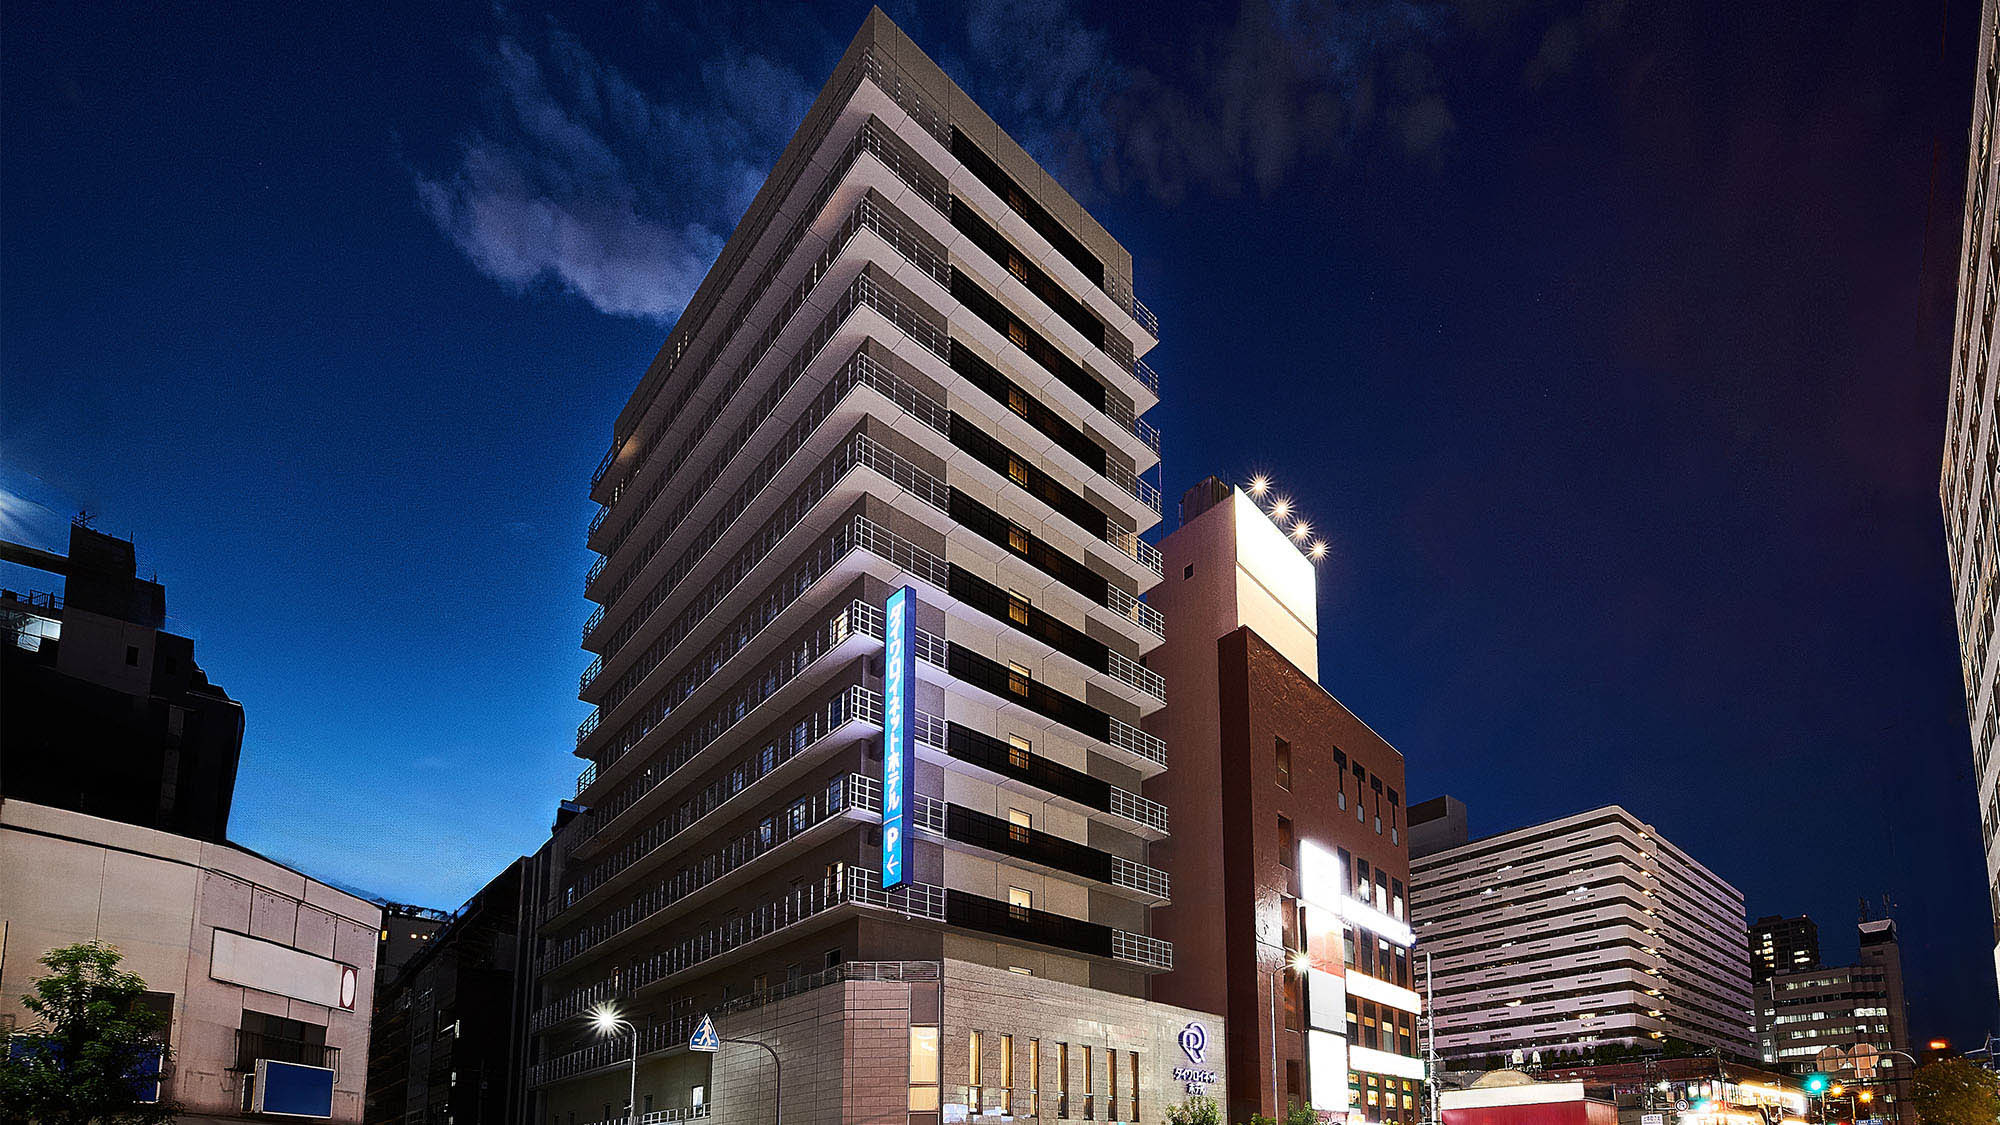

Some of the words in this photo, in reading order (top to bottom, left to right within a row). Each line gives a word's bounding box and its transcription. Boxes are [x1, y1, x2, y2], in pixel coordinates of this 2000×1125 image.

[888, 600, 905, 813] ダイワロイネットホテル
[887, 827, 899, 853] P
